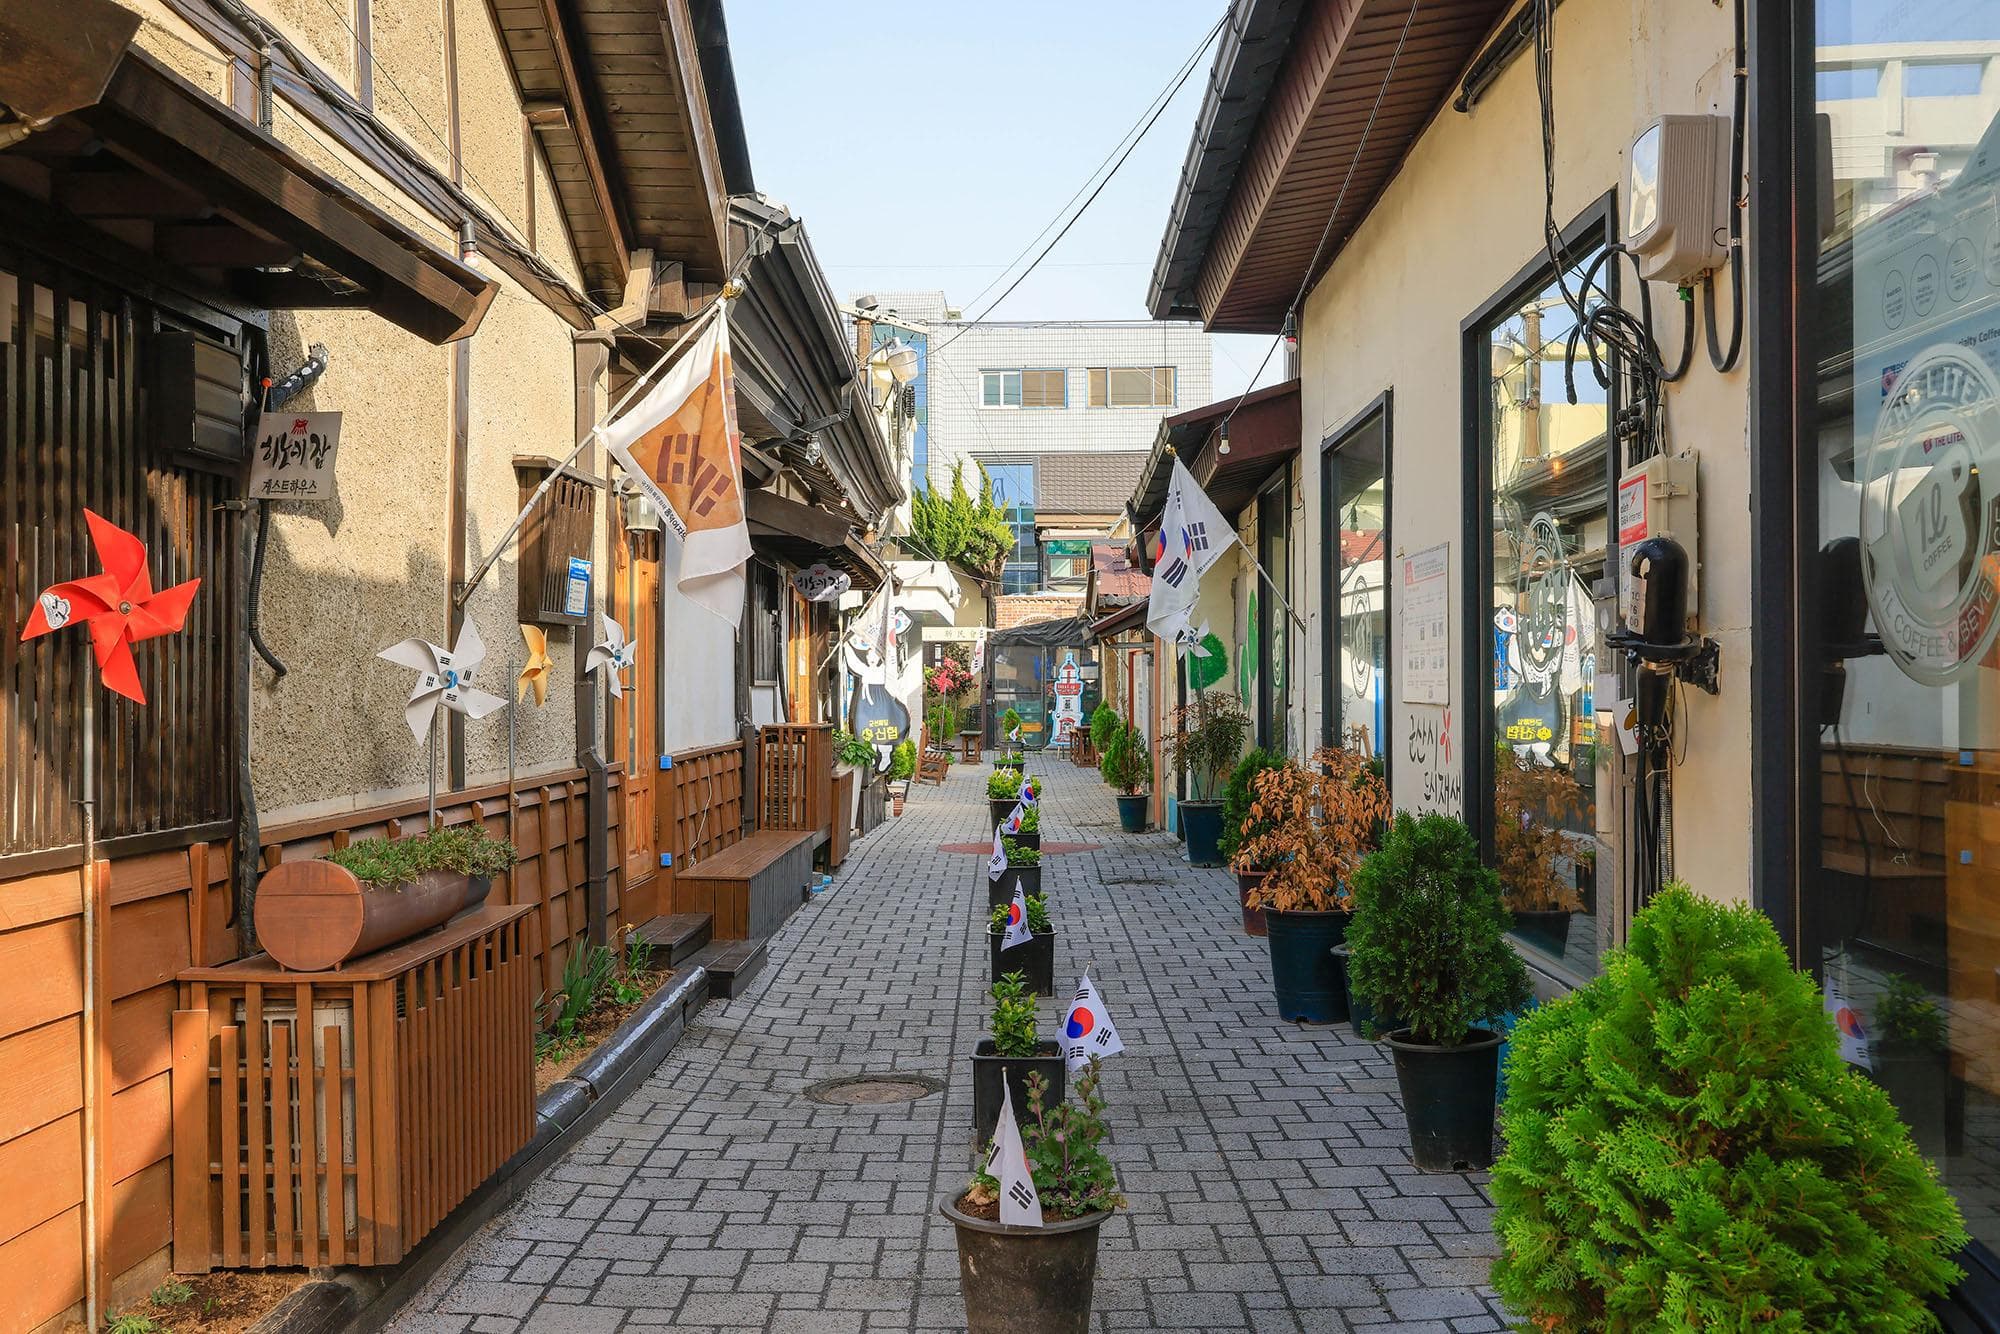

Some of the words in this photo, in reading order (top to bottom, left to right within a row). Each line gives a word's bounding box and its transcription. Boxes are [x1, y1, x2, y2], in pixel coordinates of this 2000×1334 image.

[261, 478, 317, 497] 게스트하우스
[1922, 535, 1953, 572] COFFEE
[1894, 614, 1945, 657] COFFEE
[1947, 629, 1957, 653] &
[874, 726, 898, 741] 신협
[1408, 714, 1438, 771] 군산시
